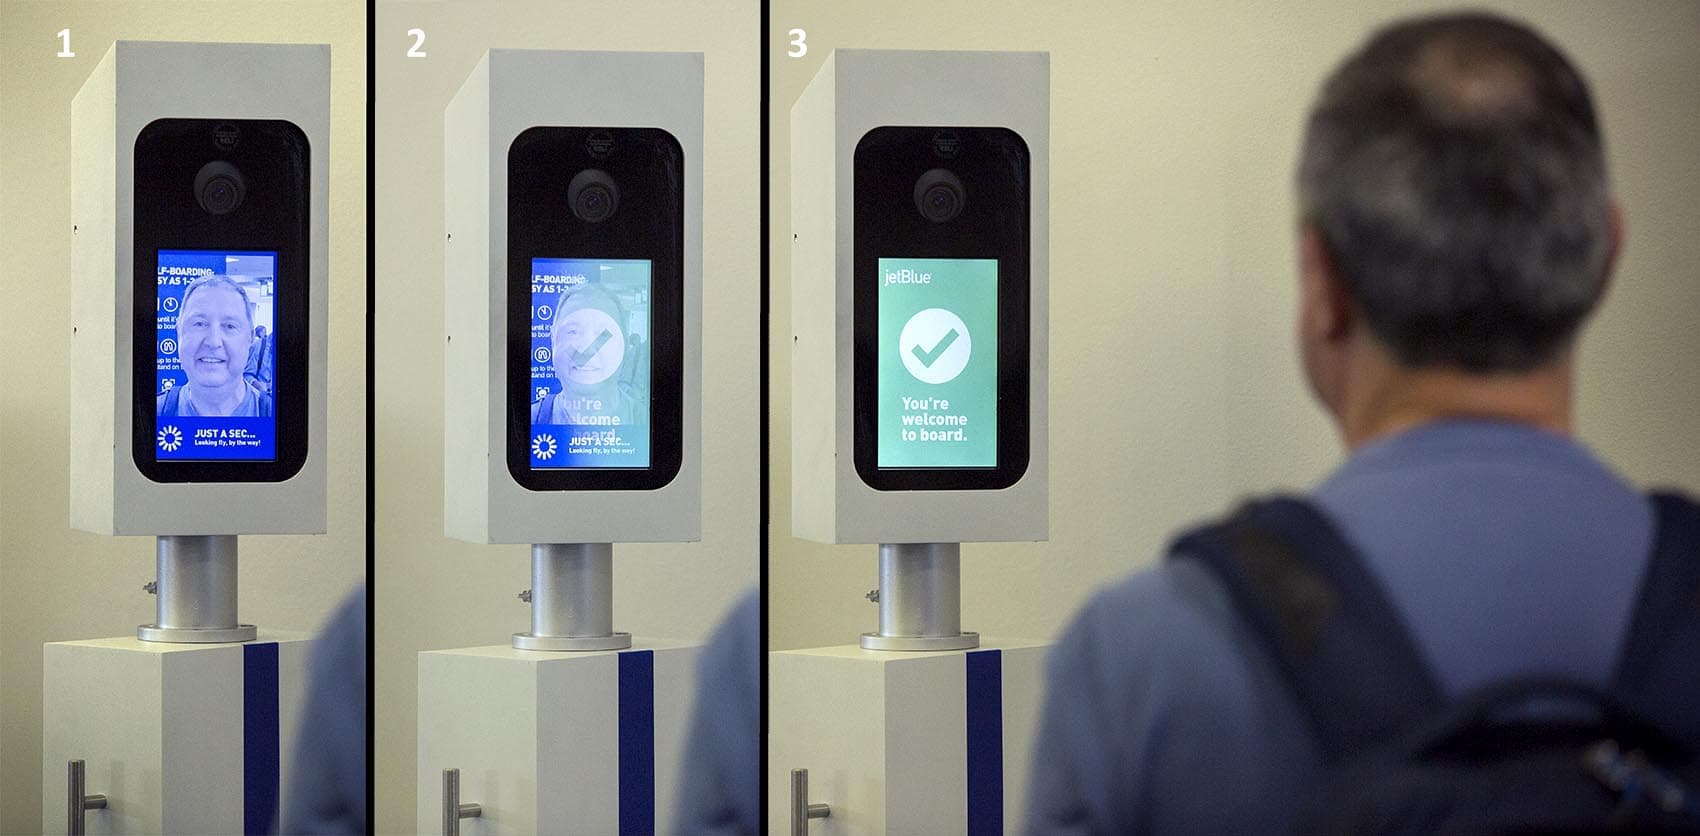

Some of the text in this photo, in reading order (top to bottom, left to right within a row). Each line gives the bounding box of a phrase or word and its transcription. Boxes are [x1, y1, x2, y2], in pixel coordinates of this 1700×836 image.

[169, 276, 181, 285] AS
[884, 269, 932, 287] jetBlue
[543, 285, 555, 293] AS
[902, 397, 949, 410] You're
[902, 413, 968, 426] welcome
[194, 429, 256, 438] JUST A SEC...
[902, 428, 968, 441] to board.
[569, 437, 593, 446] JUST
[594, 437, 602, 446] A
